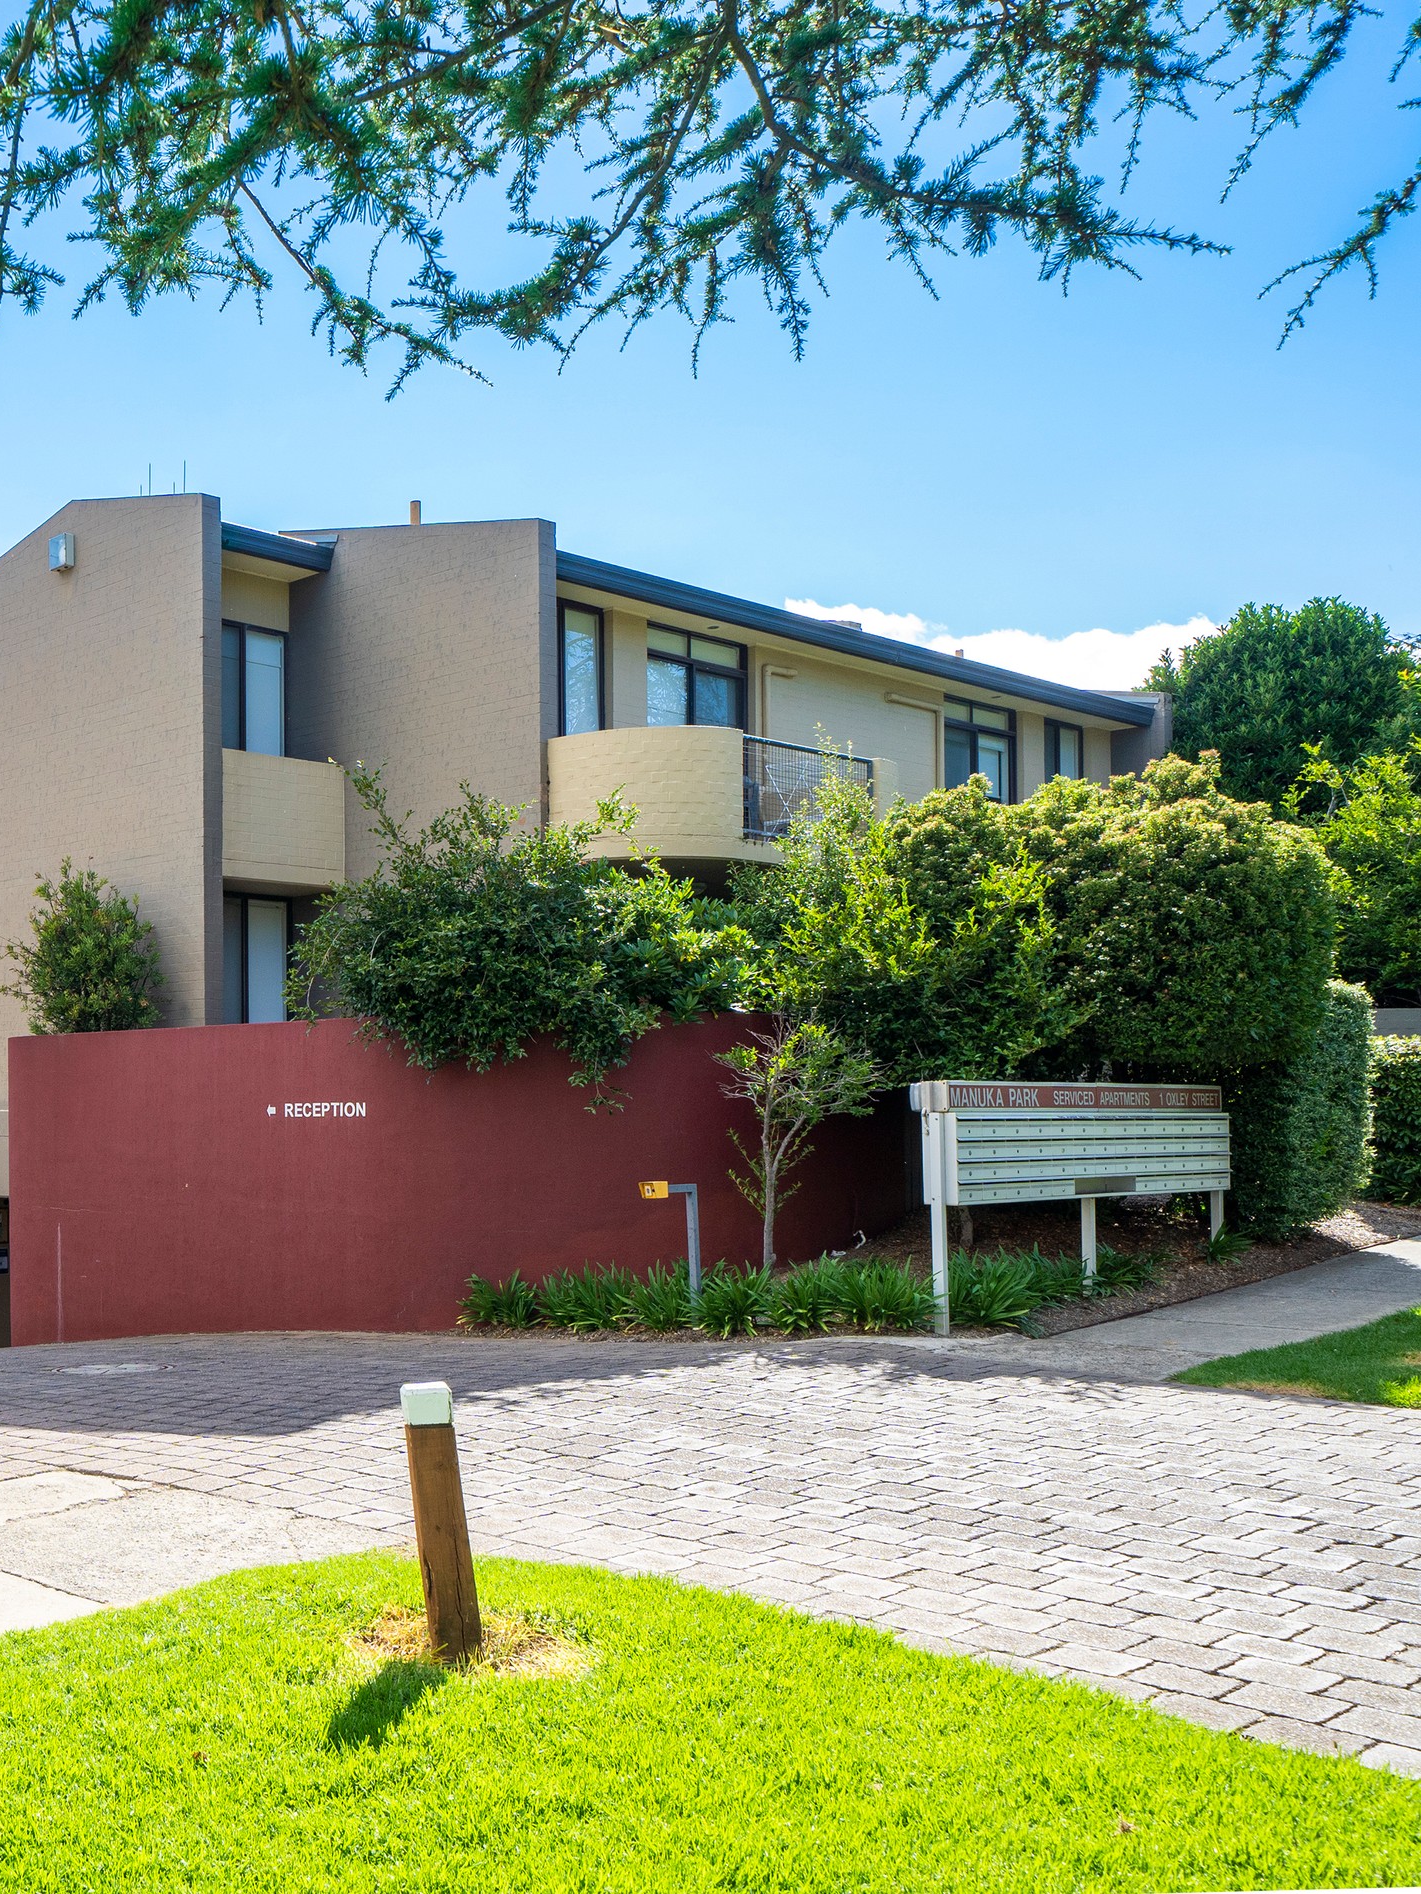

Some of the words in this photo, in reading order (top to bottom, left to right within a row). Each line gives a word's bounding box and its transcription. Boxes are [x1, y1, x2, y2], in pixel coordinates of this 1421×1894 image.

[950, 1087, 1004, 1107] MANUKA
[1009, 1088, 1040, 1107] PARK
[1053, 1090, 1095, 1105] SERVICED
[1100, 1092, 1151, 1106] APARTMENTS
[1160, 1093, 1164, 1106] 1
[1166, 1093, 1189, 1106] OXLEY
[1192, 1093, 1219, 1106] STREET
[284, 1102, 366, 1117] RECEPTION
